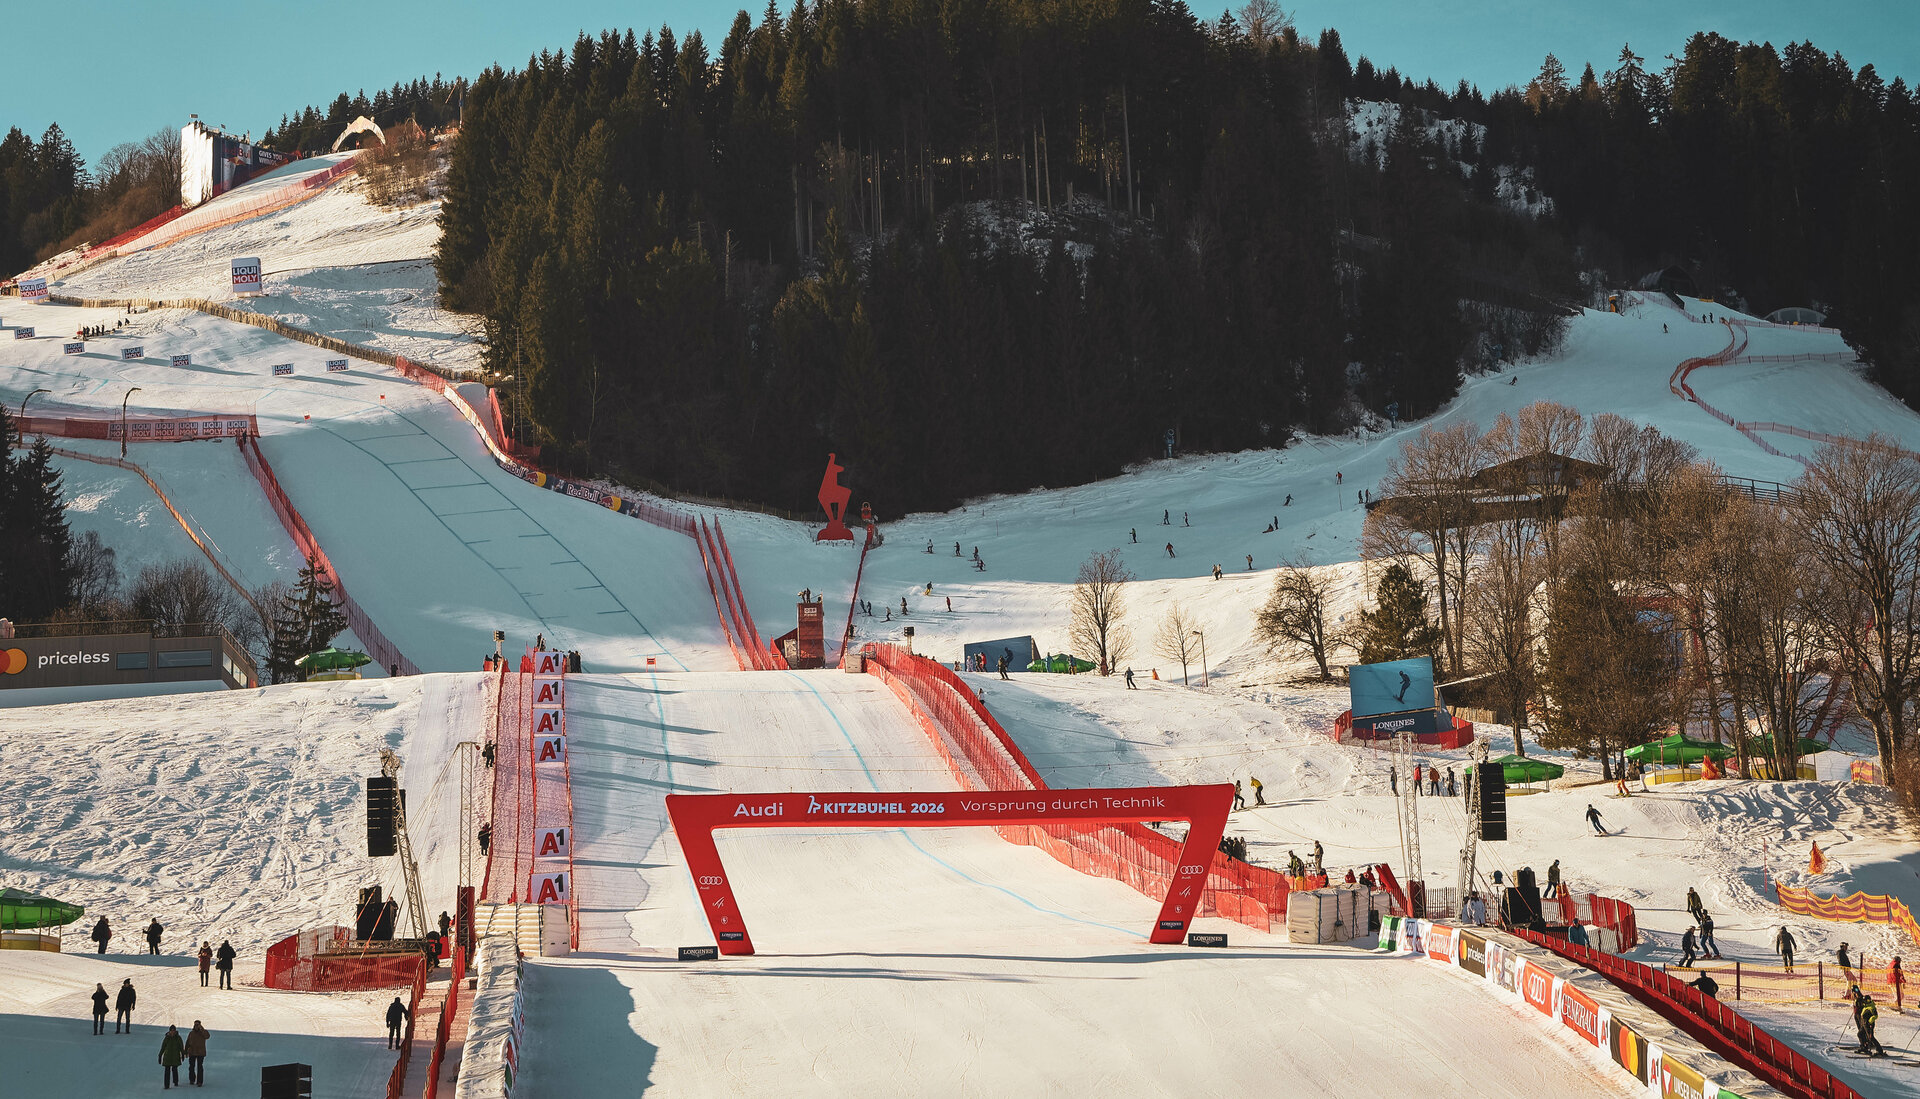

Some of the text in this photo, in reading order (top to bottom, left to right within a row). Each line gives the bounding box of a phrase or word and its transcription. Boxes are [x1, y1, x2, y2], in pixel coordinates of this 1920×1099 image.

[232, 266, 256, 276] LIQUI
[233, 274, 257, 284] MOLY
[510, 462, 528, 478] Bull
[566, 483, 600, 502] Red Bull
[38, 651, 110, 668] priceless
[539, 653, 559, 673] A1
[537, 681, 558, 702] A1
[537, 711, 558, 732] A1
[1374, 718, 1415, 730] LONGINES
[539, 738, 561, 761] A1
[734, 796, 1166, 817] Audi KITZBÜHEL 2026 Vorsprung durch Technik
[540, 829, 564, 855] A1
[537, 874, 564, 904] A1
[1467, 945, 1485, 964] priceless
[1561, 993, 1597, 1038] GENERALI
[1601, 1020, 1608, 1046] A1
[1650, 1058, 1659, 1085] A1
[1673, 1076, 1690, 1099] UNSER
